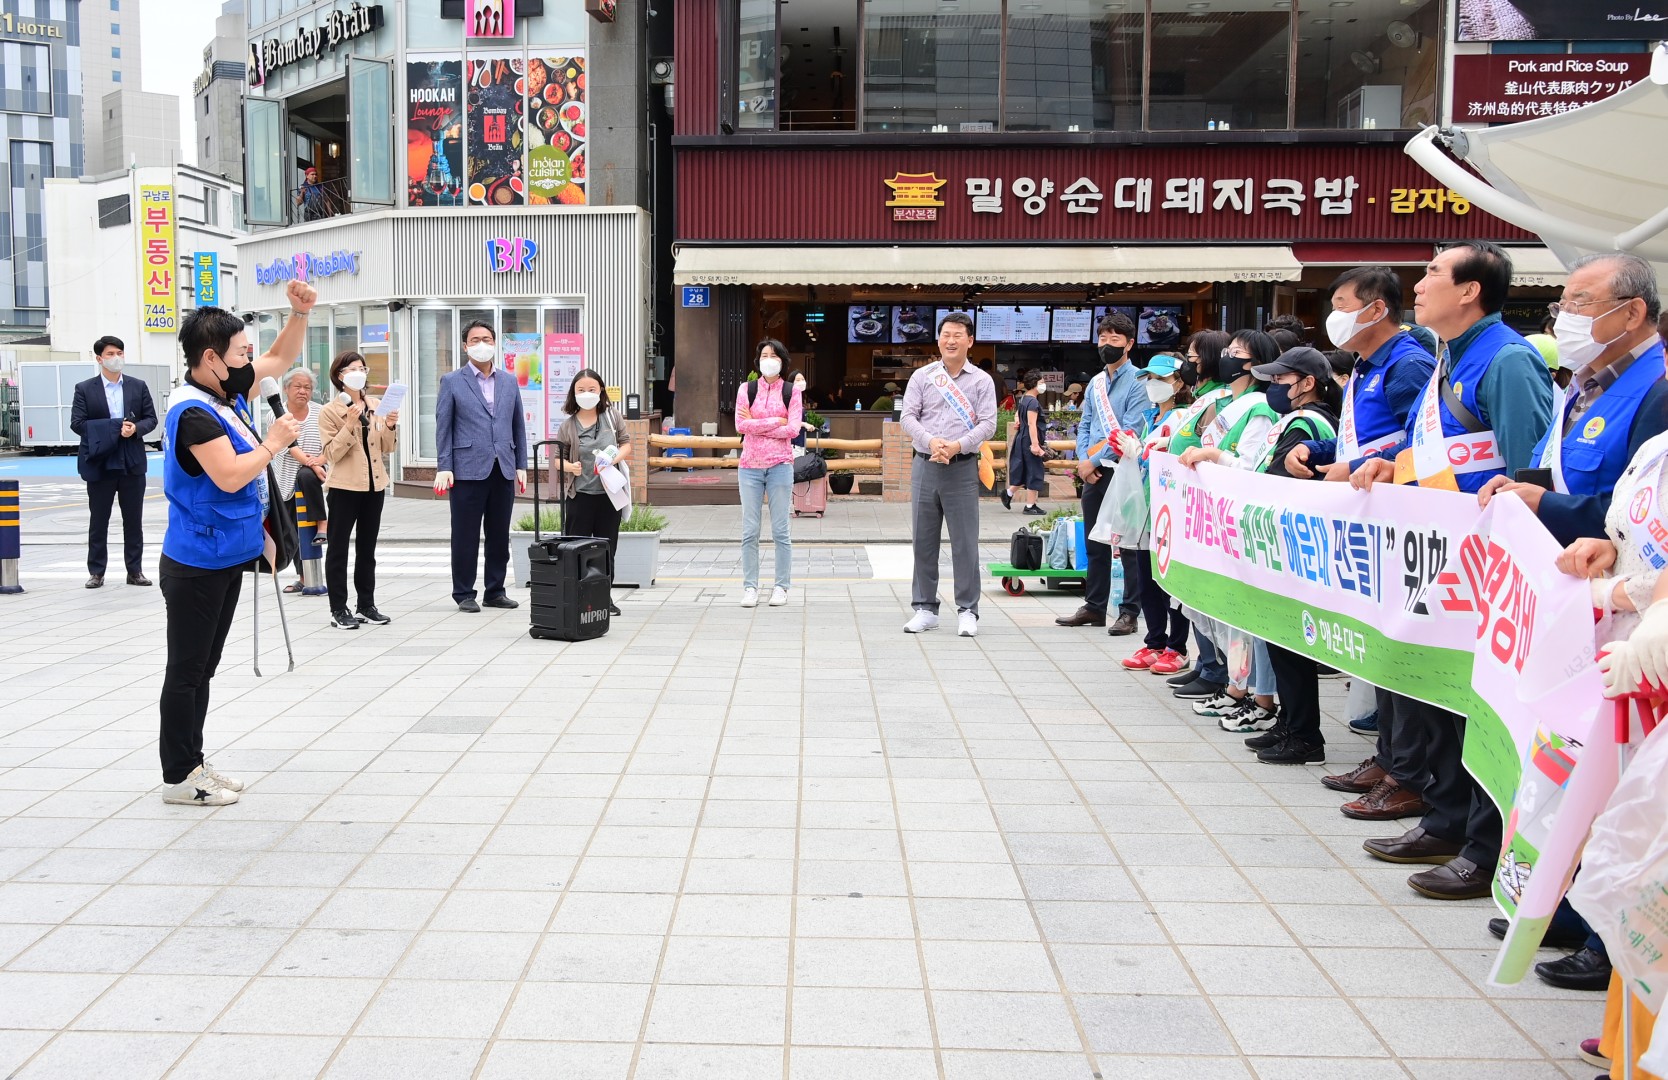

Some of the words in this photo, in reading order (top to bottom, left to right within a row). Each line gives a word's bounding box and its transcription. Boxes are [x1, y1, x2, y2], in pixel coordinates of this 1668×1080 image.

[17, 23, 63, 38] HOTEL
[263, 27, 322, 75] Bombay
[1509, 60, 1537, 72] Pork
[1539, 60, 1563, 72] and
[1566, 60, 1593, 72] Rice
[1596, 60, 1629, 74] Soup
[410, 88, 455, 103] HOOKAH
[410, 99, 453, 130] Lounge
[533, 158, 565, 167] indian
[529, 167, 565, 177] cuisine
[142, 191, 171, 201] 구남로
[965, 175, 1359, 216] 밀양순대돼지국밥
[894, 208, 936, 220] 부산본점
[145, 207, 172, 296] 부동산
[486, 236, 538, 272] BR
[256, 261, 292, 285] baskin
[312, 250, 357, 277] robbins
[198, 255, 215, 302] 부동산
[689, 293, 704, 303] 28
[145, 304, 172, 315] 744-
[145, 317, 174, 328] 4490
[1239, 504, 1282, 571] 쾌적한
[1280, 507, 1331, 587] 해운대
[580, 608, 608, 624] MIPRO
[1318, 617, 1366, 664] 해운대구
